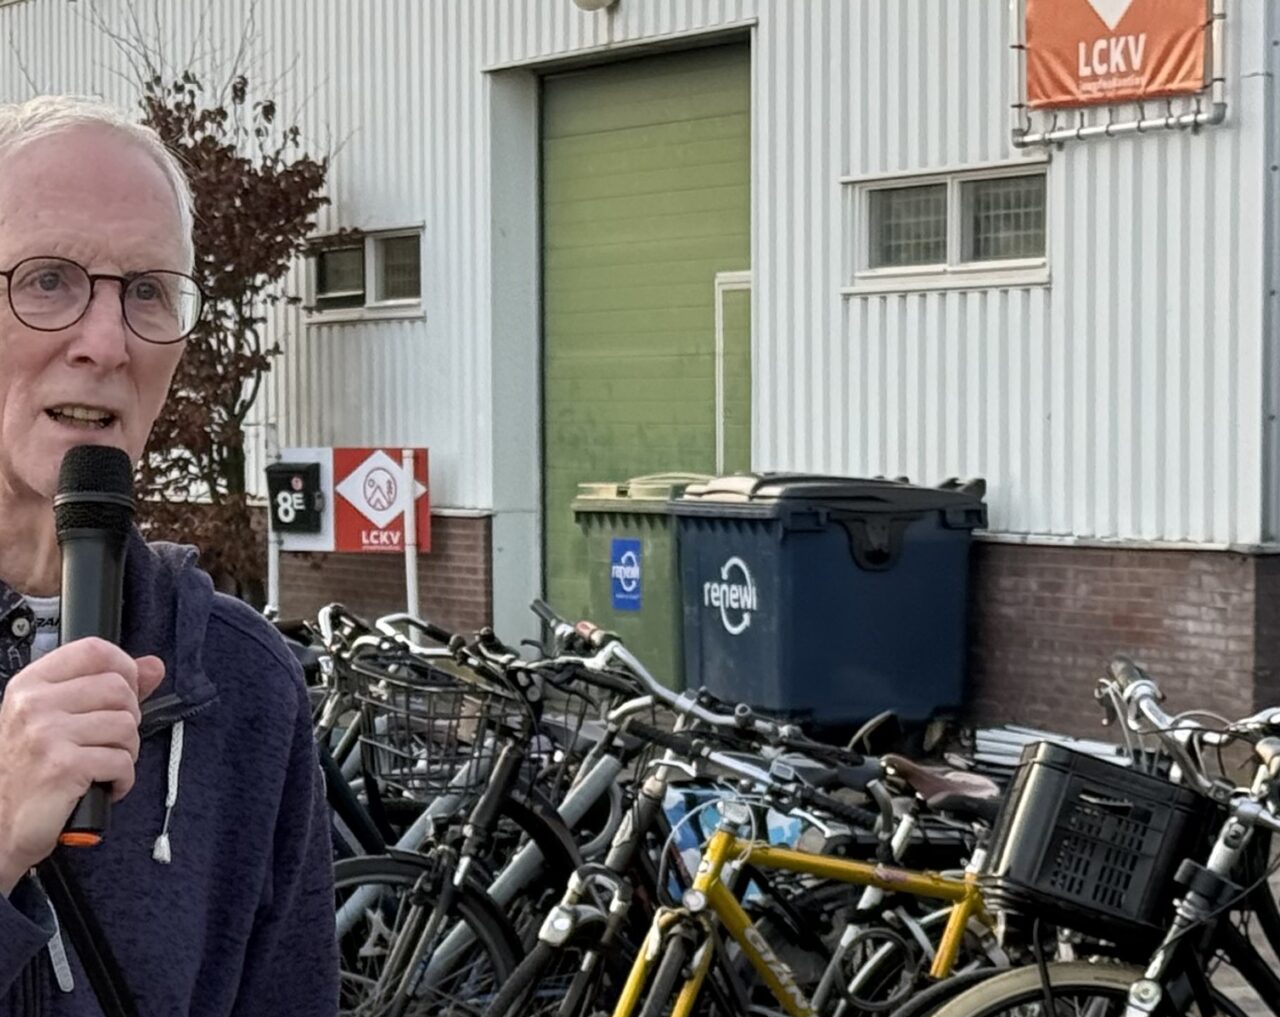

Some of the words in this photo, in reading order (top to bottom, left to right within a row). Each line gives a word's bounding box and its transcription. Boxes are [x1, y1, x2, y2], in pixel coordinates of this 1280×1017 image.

[1078, 33, 1146, 77] LCKV
[277, 491, 305, 523] 8E
[361, 530, 401, 545] LCKV
[703, 581, 757, 611] renewi
